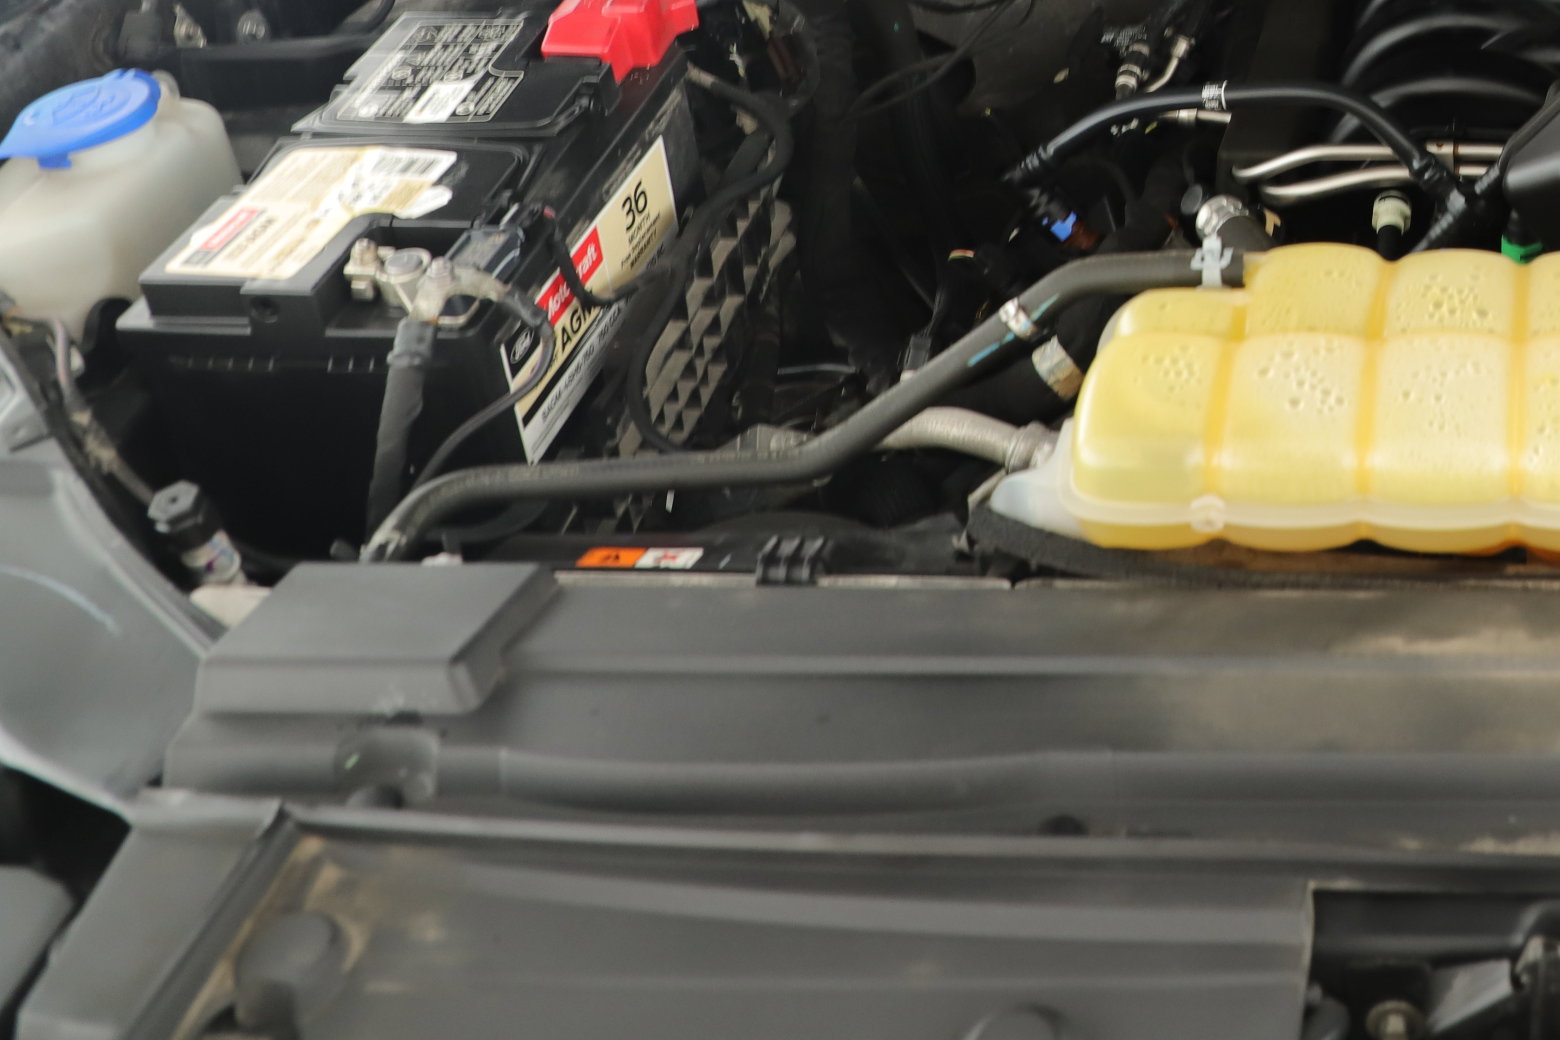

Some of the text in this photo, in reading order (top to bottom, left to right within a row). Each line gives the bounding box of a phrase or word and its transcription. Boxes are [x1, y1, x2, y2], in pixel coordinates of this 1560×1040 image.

[621, 180, 648, 232] 36
[627, 210, 651, 245] MONTH
[547, 242, 598, 322] Motoraft
